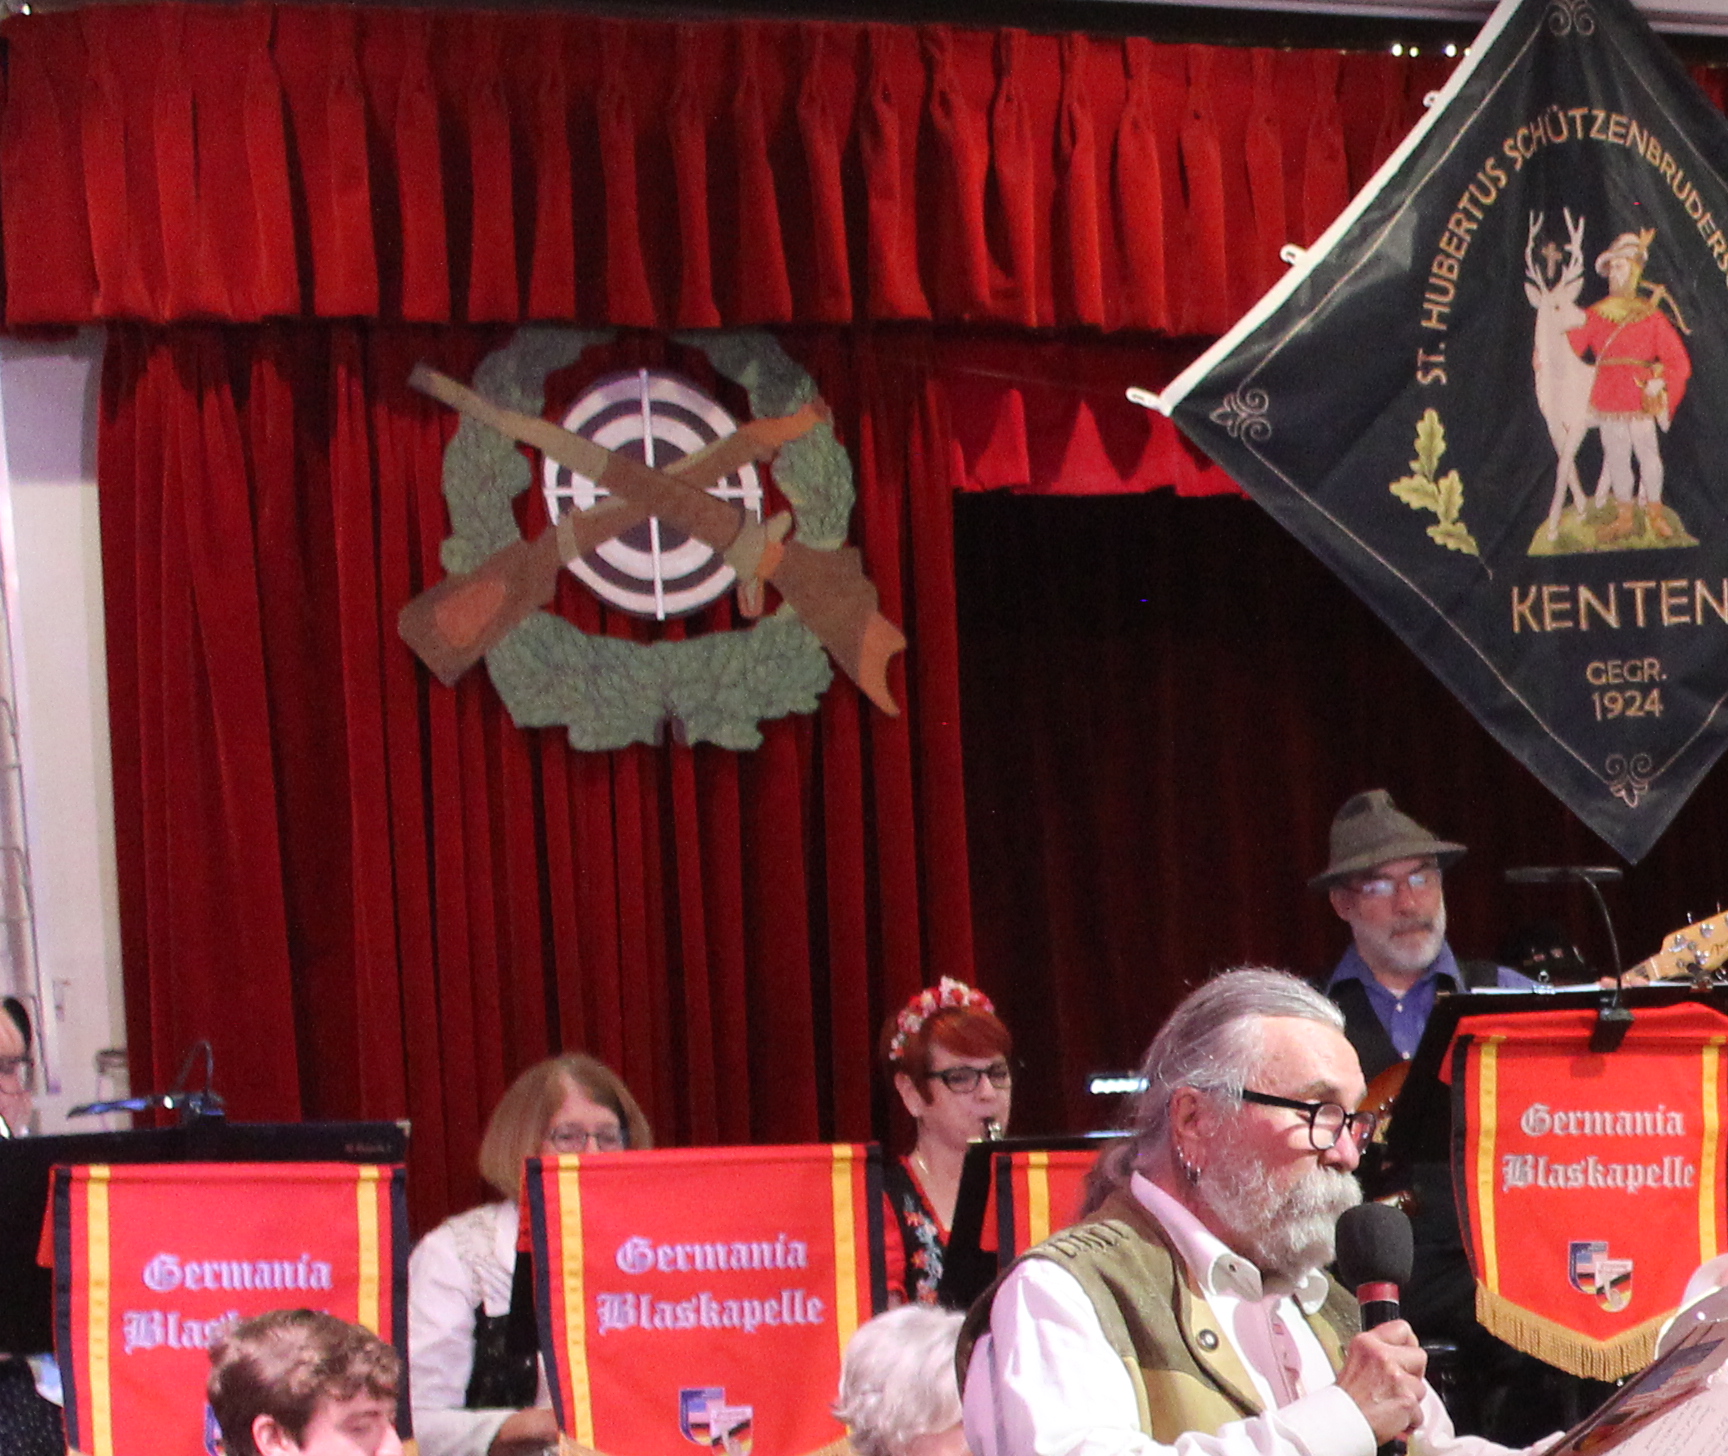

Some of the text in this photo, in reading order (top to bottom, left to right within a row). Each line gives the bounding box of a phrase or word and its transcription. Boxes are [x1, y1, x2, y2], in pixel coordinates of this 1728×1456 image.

[1420, 157, 1509, 330] HUBERTUS
[1416, 342, 1447, 386] ST.
[1586, 658, 1668, 685] GEGR.
[1591, 688, 1663, 721] 1924
[1520, 1102, 1686, 1136] Germania
[1502, 1154, 1695, 1194] Blaskapelle
[142, 1252, 333, 1291] Germania
[615, 1232, 808, 1275] Germania
[596, 1288, 825, 1336] Blaskapelle
